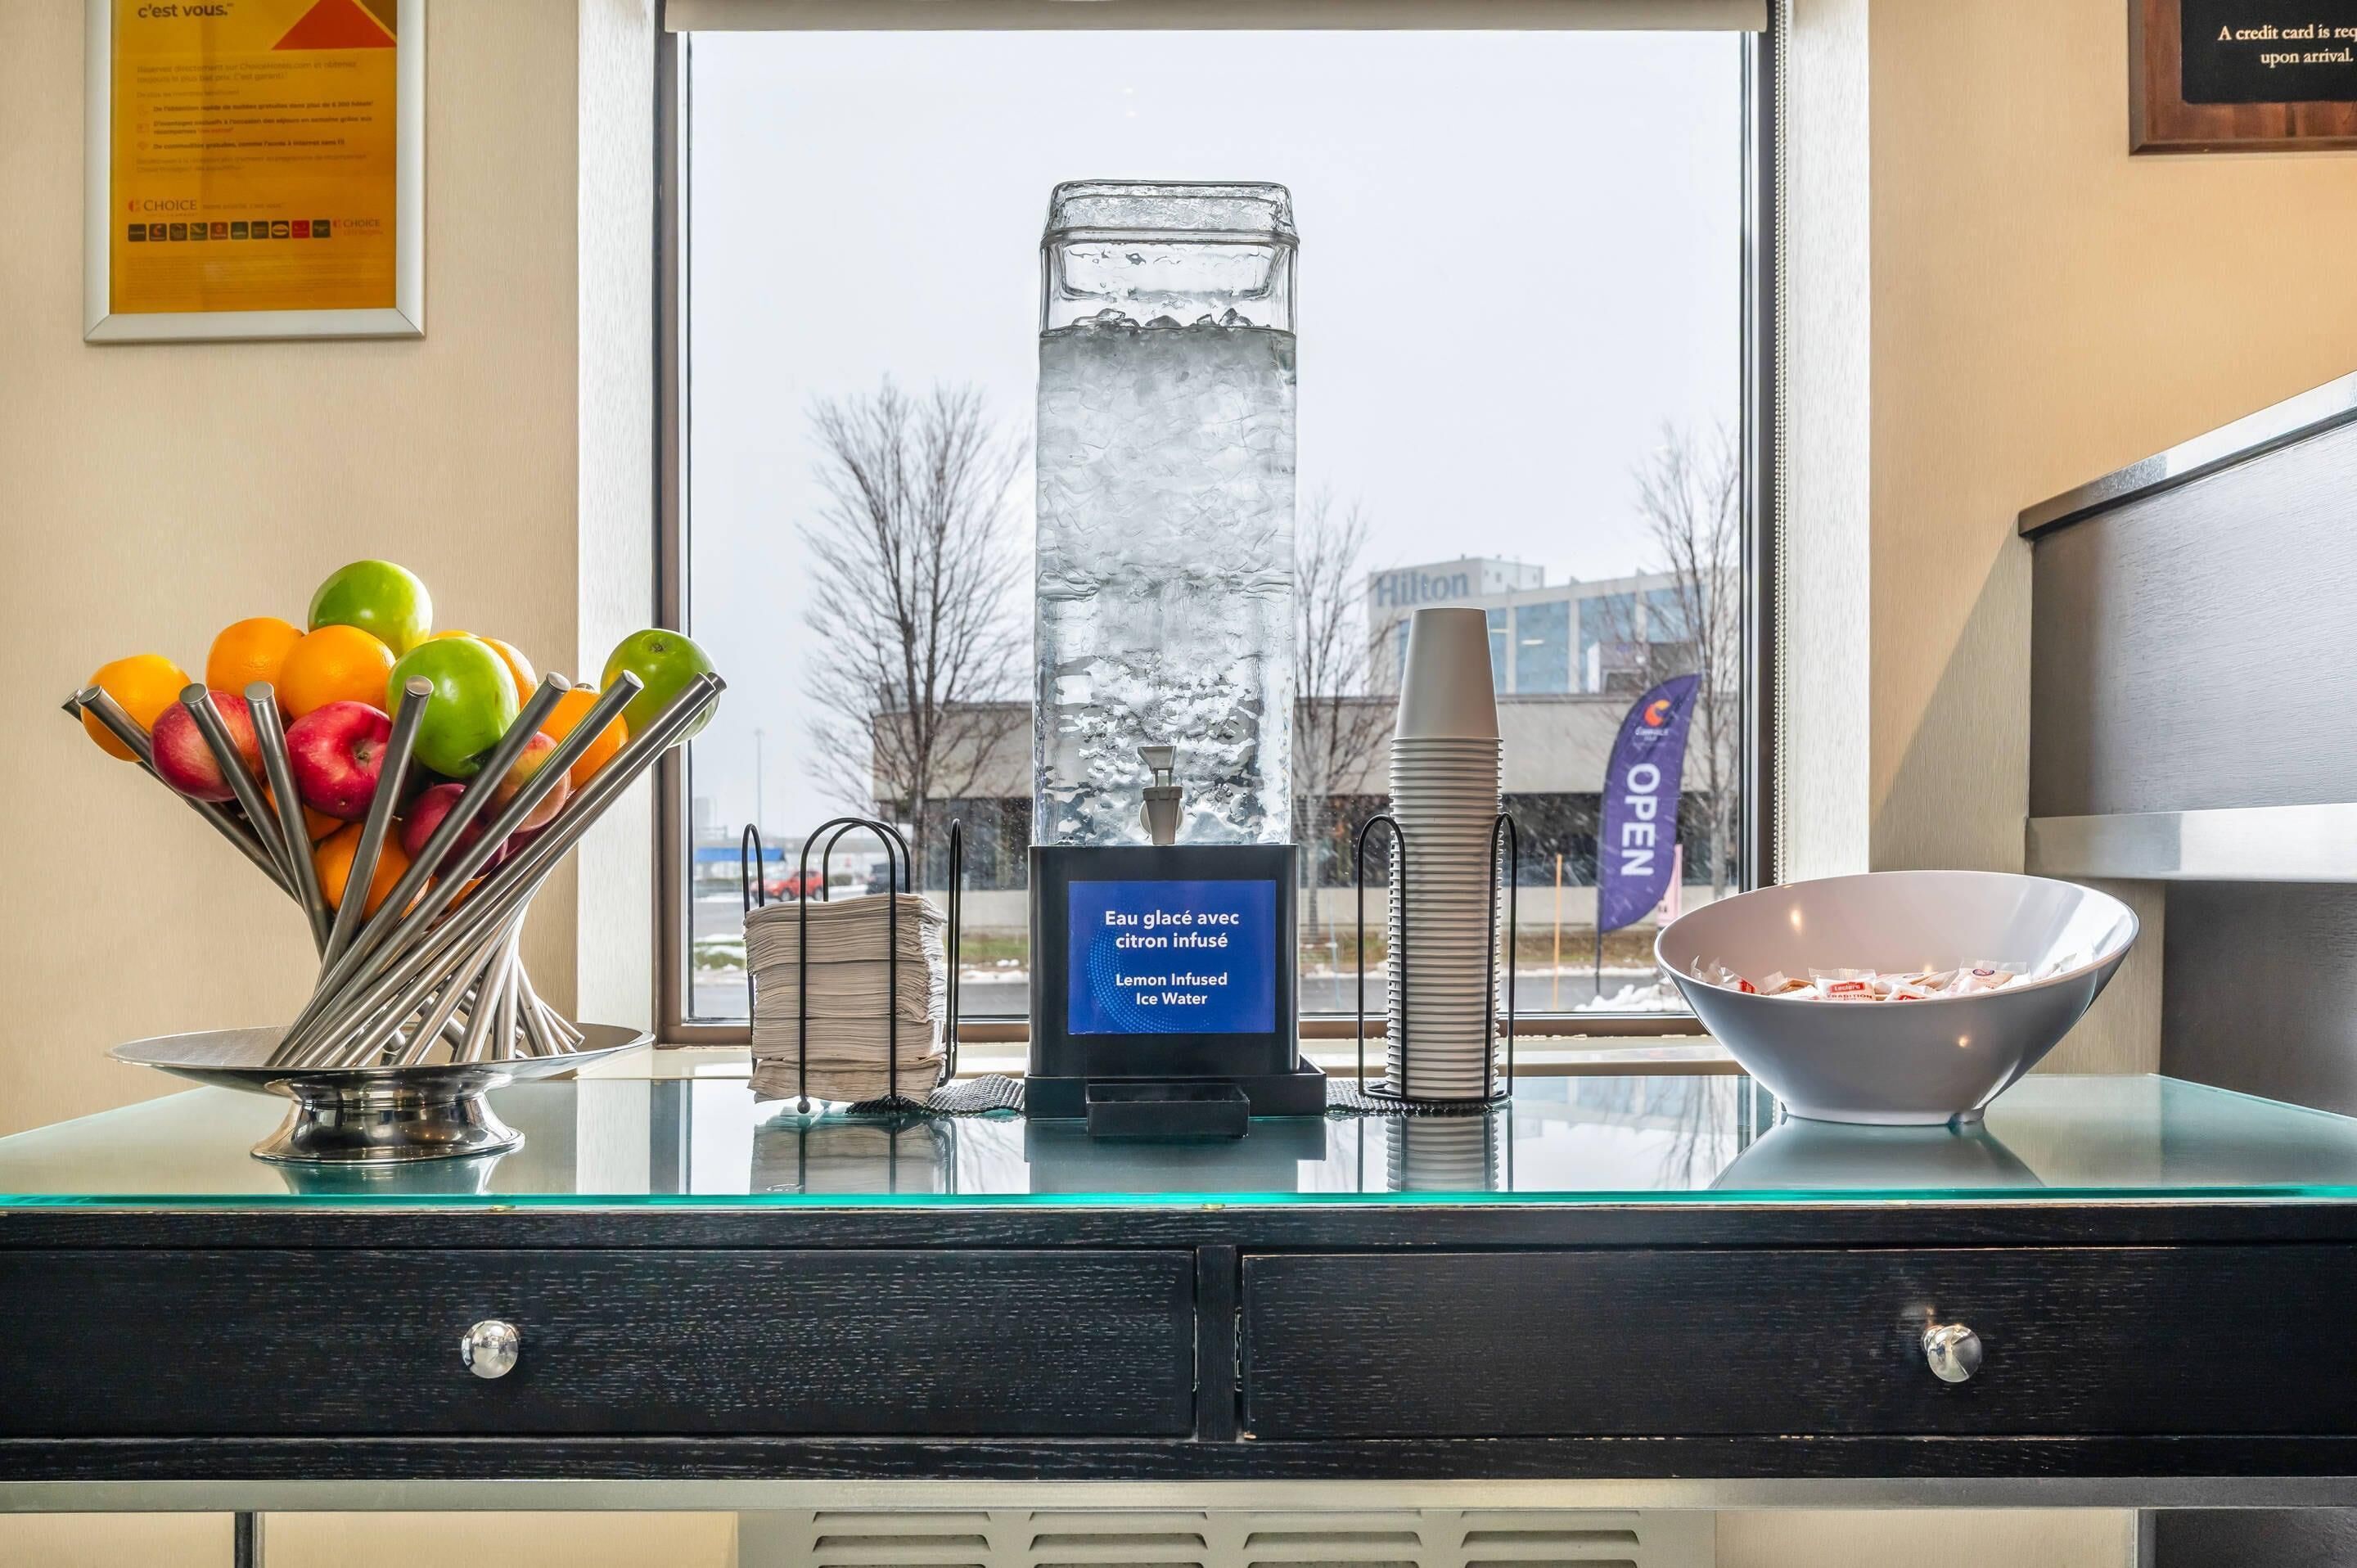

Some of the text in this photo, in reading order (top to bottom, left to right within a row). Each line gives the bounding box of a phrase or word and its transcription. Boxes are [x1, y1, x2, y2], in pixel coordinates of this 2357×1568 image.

[137, 3, 178, 17] c'est
[2217, 25, 2233, 40] A
[2236, 25, 2278, 40] credit
[2282, 24, 2314, 39] card
[2318, 24, 2331, 38] is
[2260, 47, 2355, 69] upon arrival.
[143, 199, 197, 211] CHOICE
[1377, 570, 1471, 607] Hilton
[1620, 763, 1661, 876] OPEN
[1105, 909, 1239, 930] Eau glacé avec
[1115, 931, 1228, 948] citron infusé
[1115, 971, 1228, 986] Lemon Infused
[1136, 992, 1208, 1005] Ice Water
